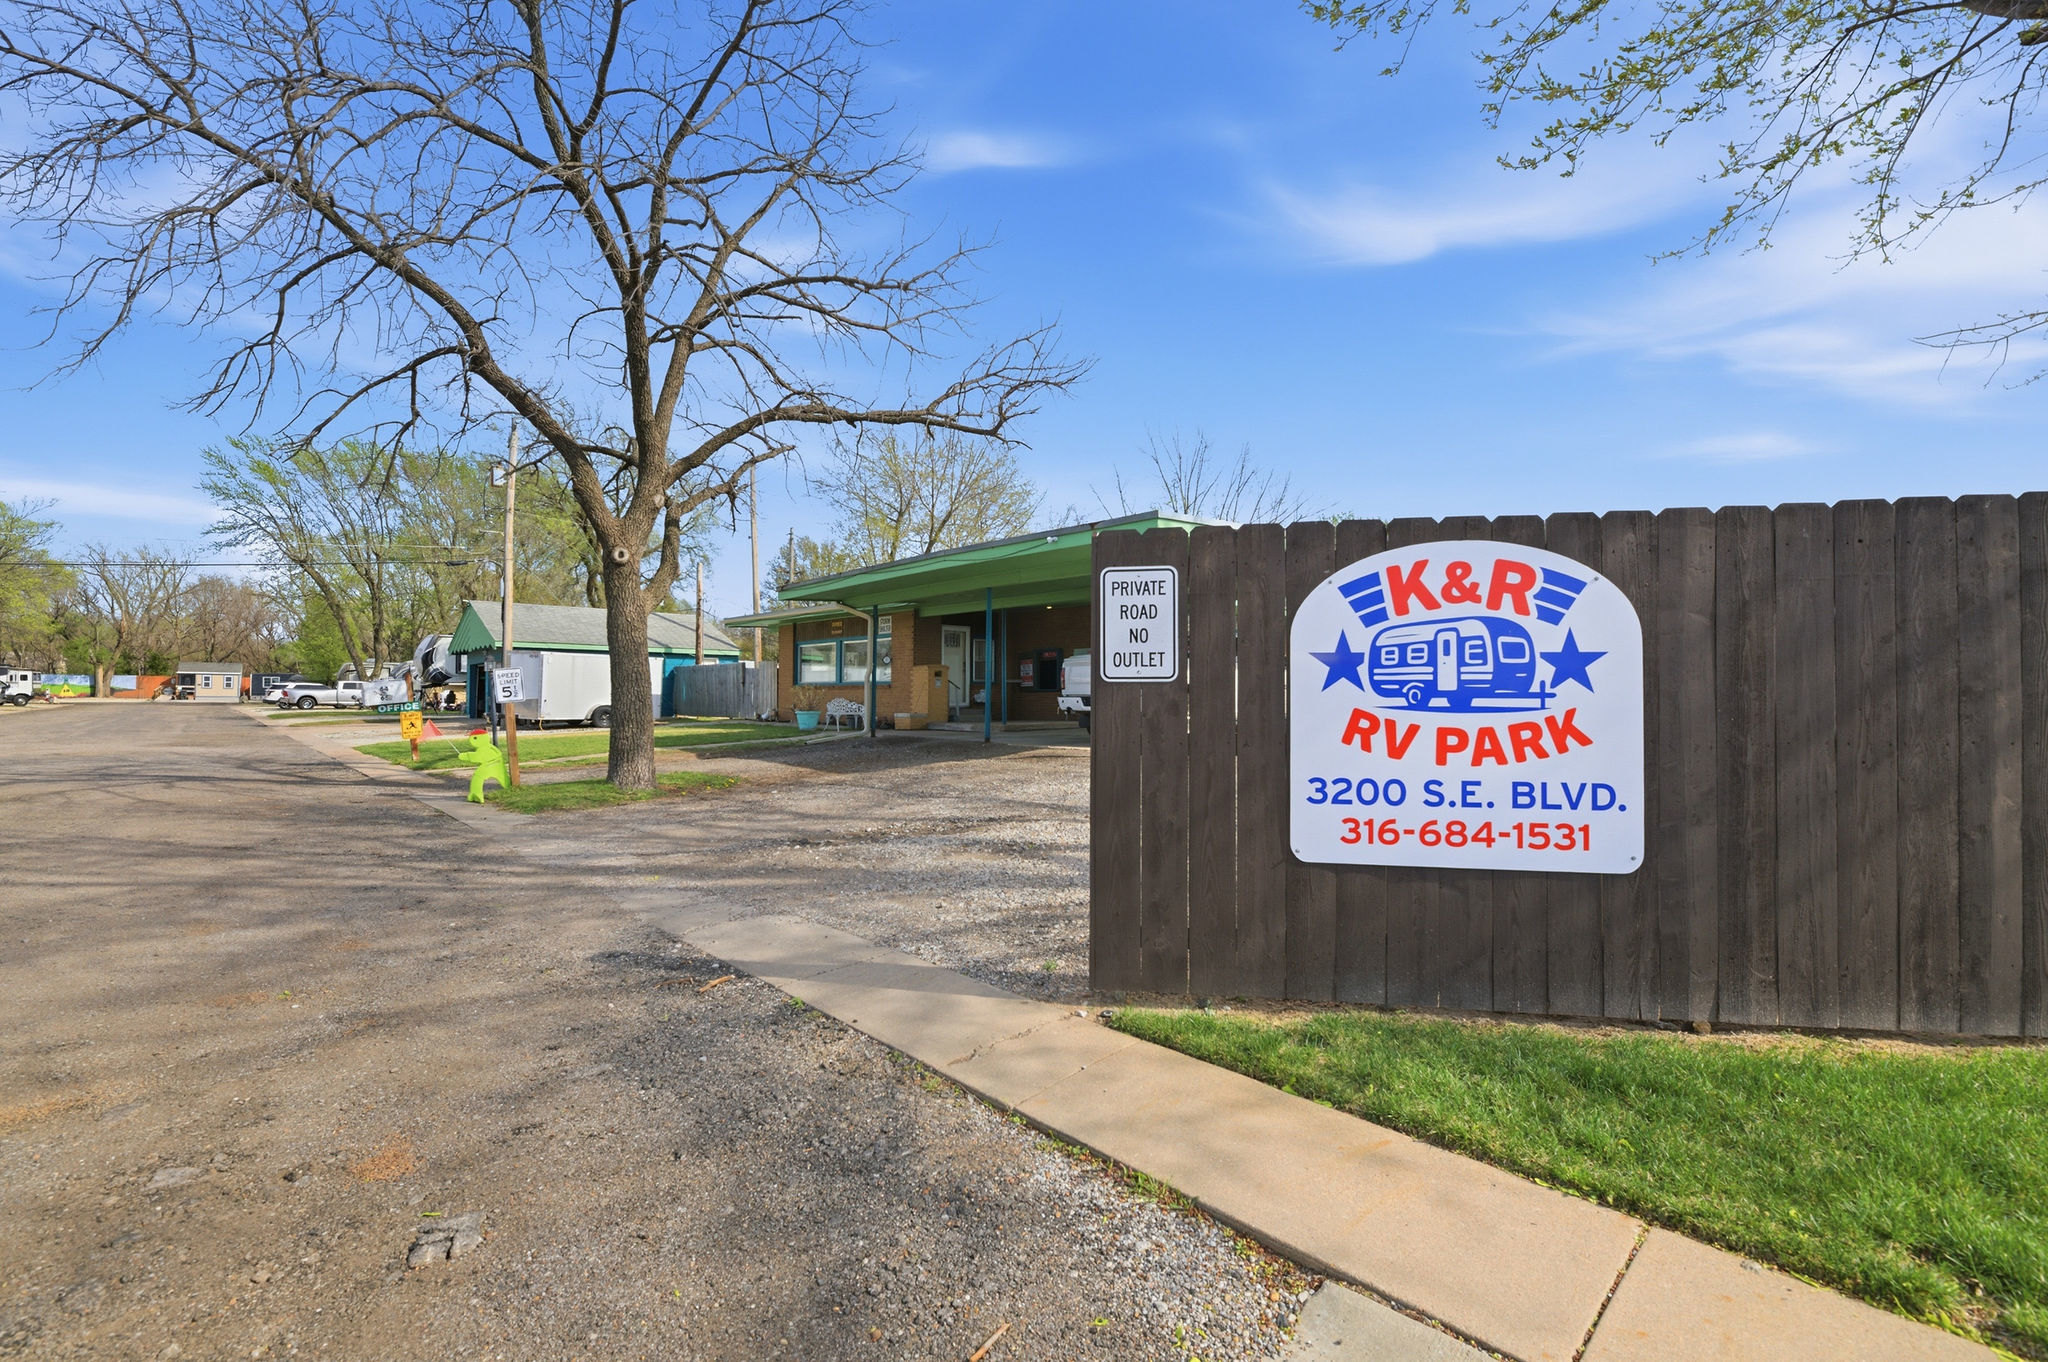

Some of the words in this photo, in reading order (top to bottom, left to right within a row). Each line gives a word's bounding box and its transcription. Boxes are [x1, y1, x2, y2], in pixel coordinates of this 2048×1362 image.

[1111, 580, 1166, 596] PRIVATE
[1386, 558, 1537, 617] K&R
[1120, 604, 1158, 620] ROAD
[1129, 628, 1149, 643] NO
[1113, 652, 1165, 667] OUTLET
[377, 702, 420, 713] OFFICE
[1341, 707, 1421, 760] RV
[1435, 707, 1593, 767] PARK
[1306, 777, 1407, 807] 3200
[1423, 779, 1495, 809] S.E.
[1511, 781, 1627, 812] BLVD.
[1340, 817, 1590, 852] 316-684-1531
